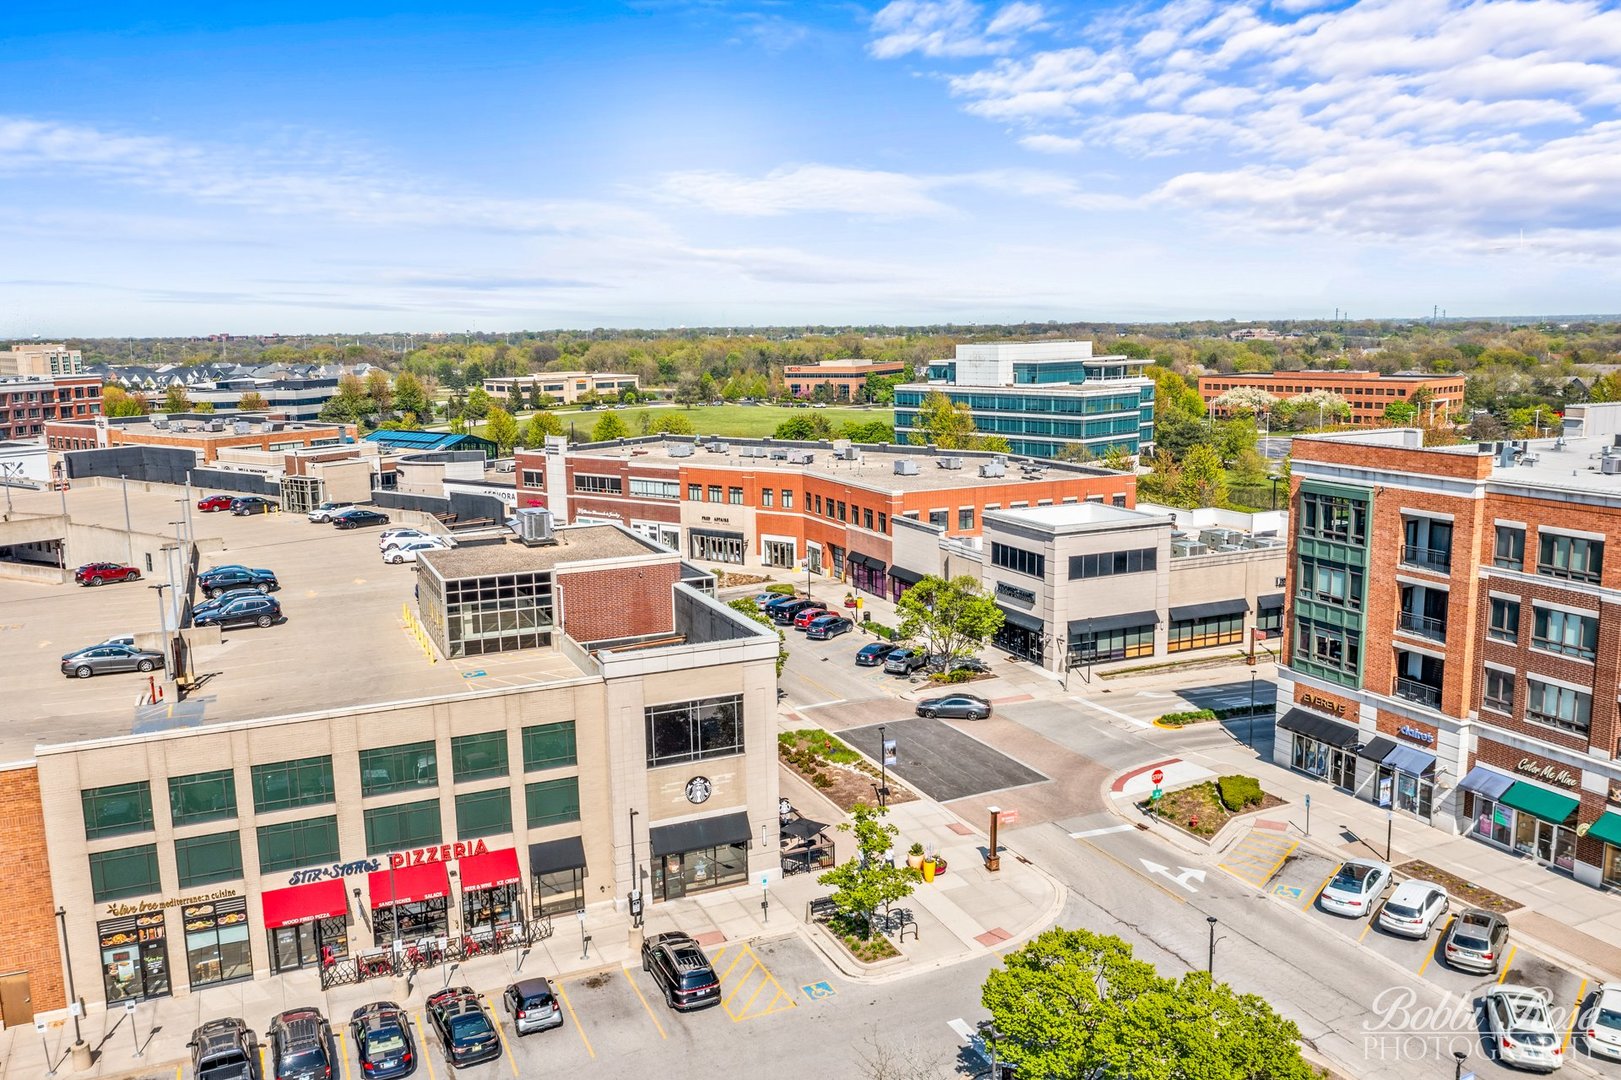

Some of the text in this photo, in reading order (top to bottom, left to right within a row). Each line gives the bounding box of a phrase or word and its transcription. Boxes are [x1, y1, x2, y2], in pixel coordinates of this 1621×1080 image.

[1303, 694, 1346, 713] EVEREVE
[1517, 758, 1578, 787] Color Me Mine
[392, 839, 489, 868] PIZZERIA
[211, 888, 236, 900] cuisine
[378, 897, 411, 907] SANDICHES
[282, 912, 331, 926] WOOD FIRED PIZZA
